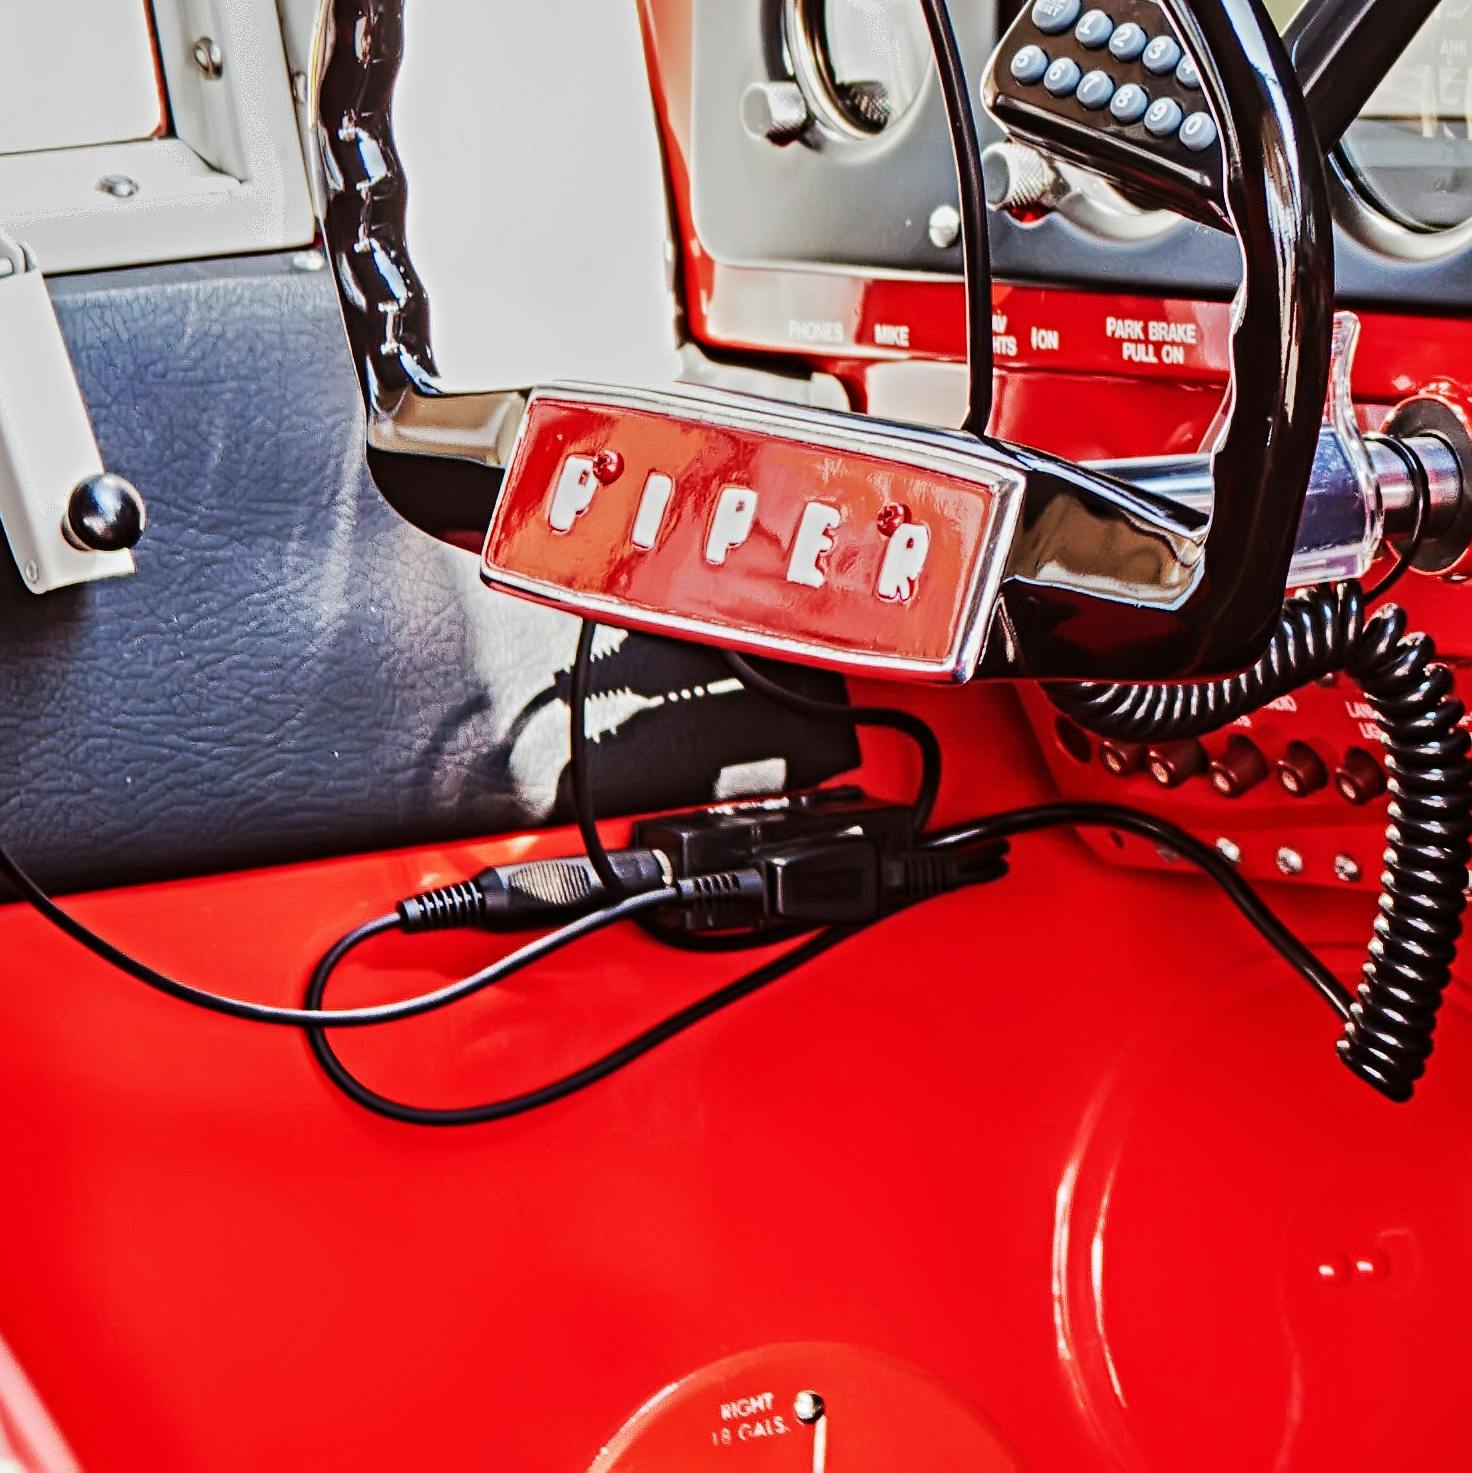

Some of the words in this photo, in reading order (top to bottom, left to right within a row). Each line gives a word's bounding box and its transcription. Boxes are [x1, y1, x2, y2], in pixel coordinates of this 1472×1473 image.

[1078, 17, 1092, 36] 1
[1113, 28, 1131, 48] 2
[1147, 40, 1167, 60] 3
[1014, 49, 1032, 69] 5
[1050, 61, 1067, 81] 6
[1081, 74, 1099, 94] 7
[1115, 90, 1133, 108] 8
[1150, 102, 1169, 122] 9
[1184, 117, 1201, 136] 0
[874, 323, 910, 347] MIKE
[1106, 316, 1144, 340] PARK
[1148, 321, 1198, 345] BRAKE
[1122, 342, 1158, 364] PULL
[1162, 345, 1185, 365] ON
[548, 453, 930, 603] PIPER
[719, 1391, 775, 1421] RIGHT
